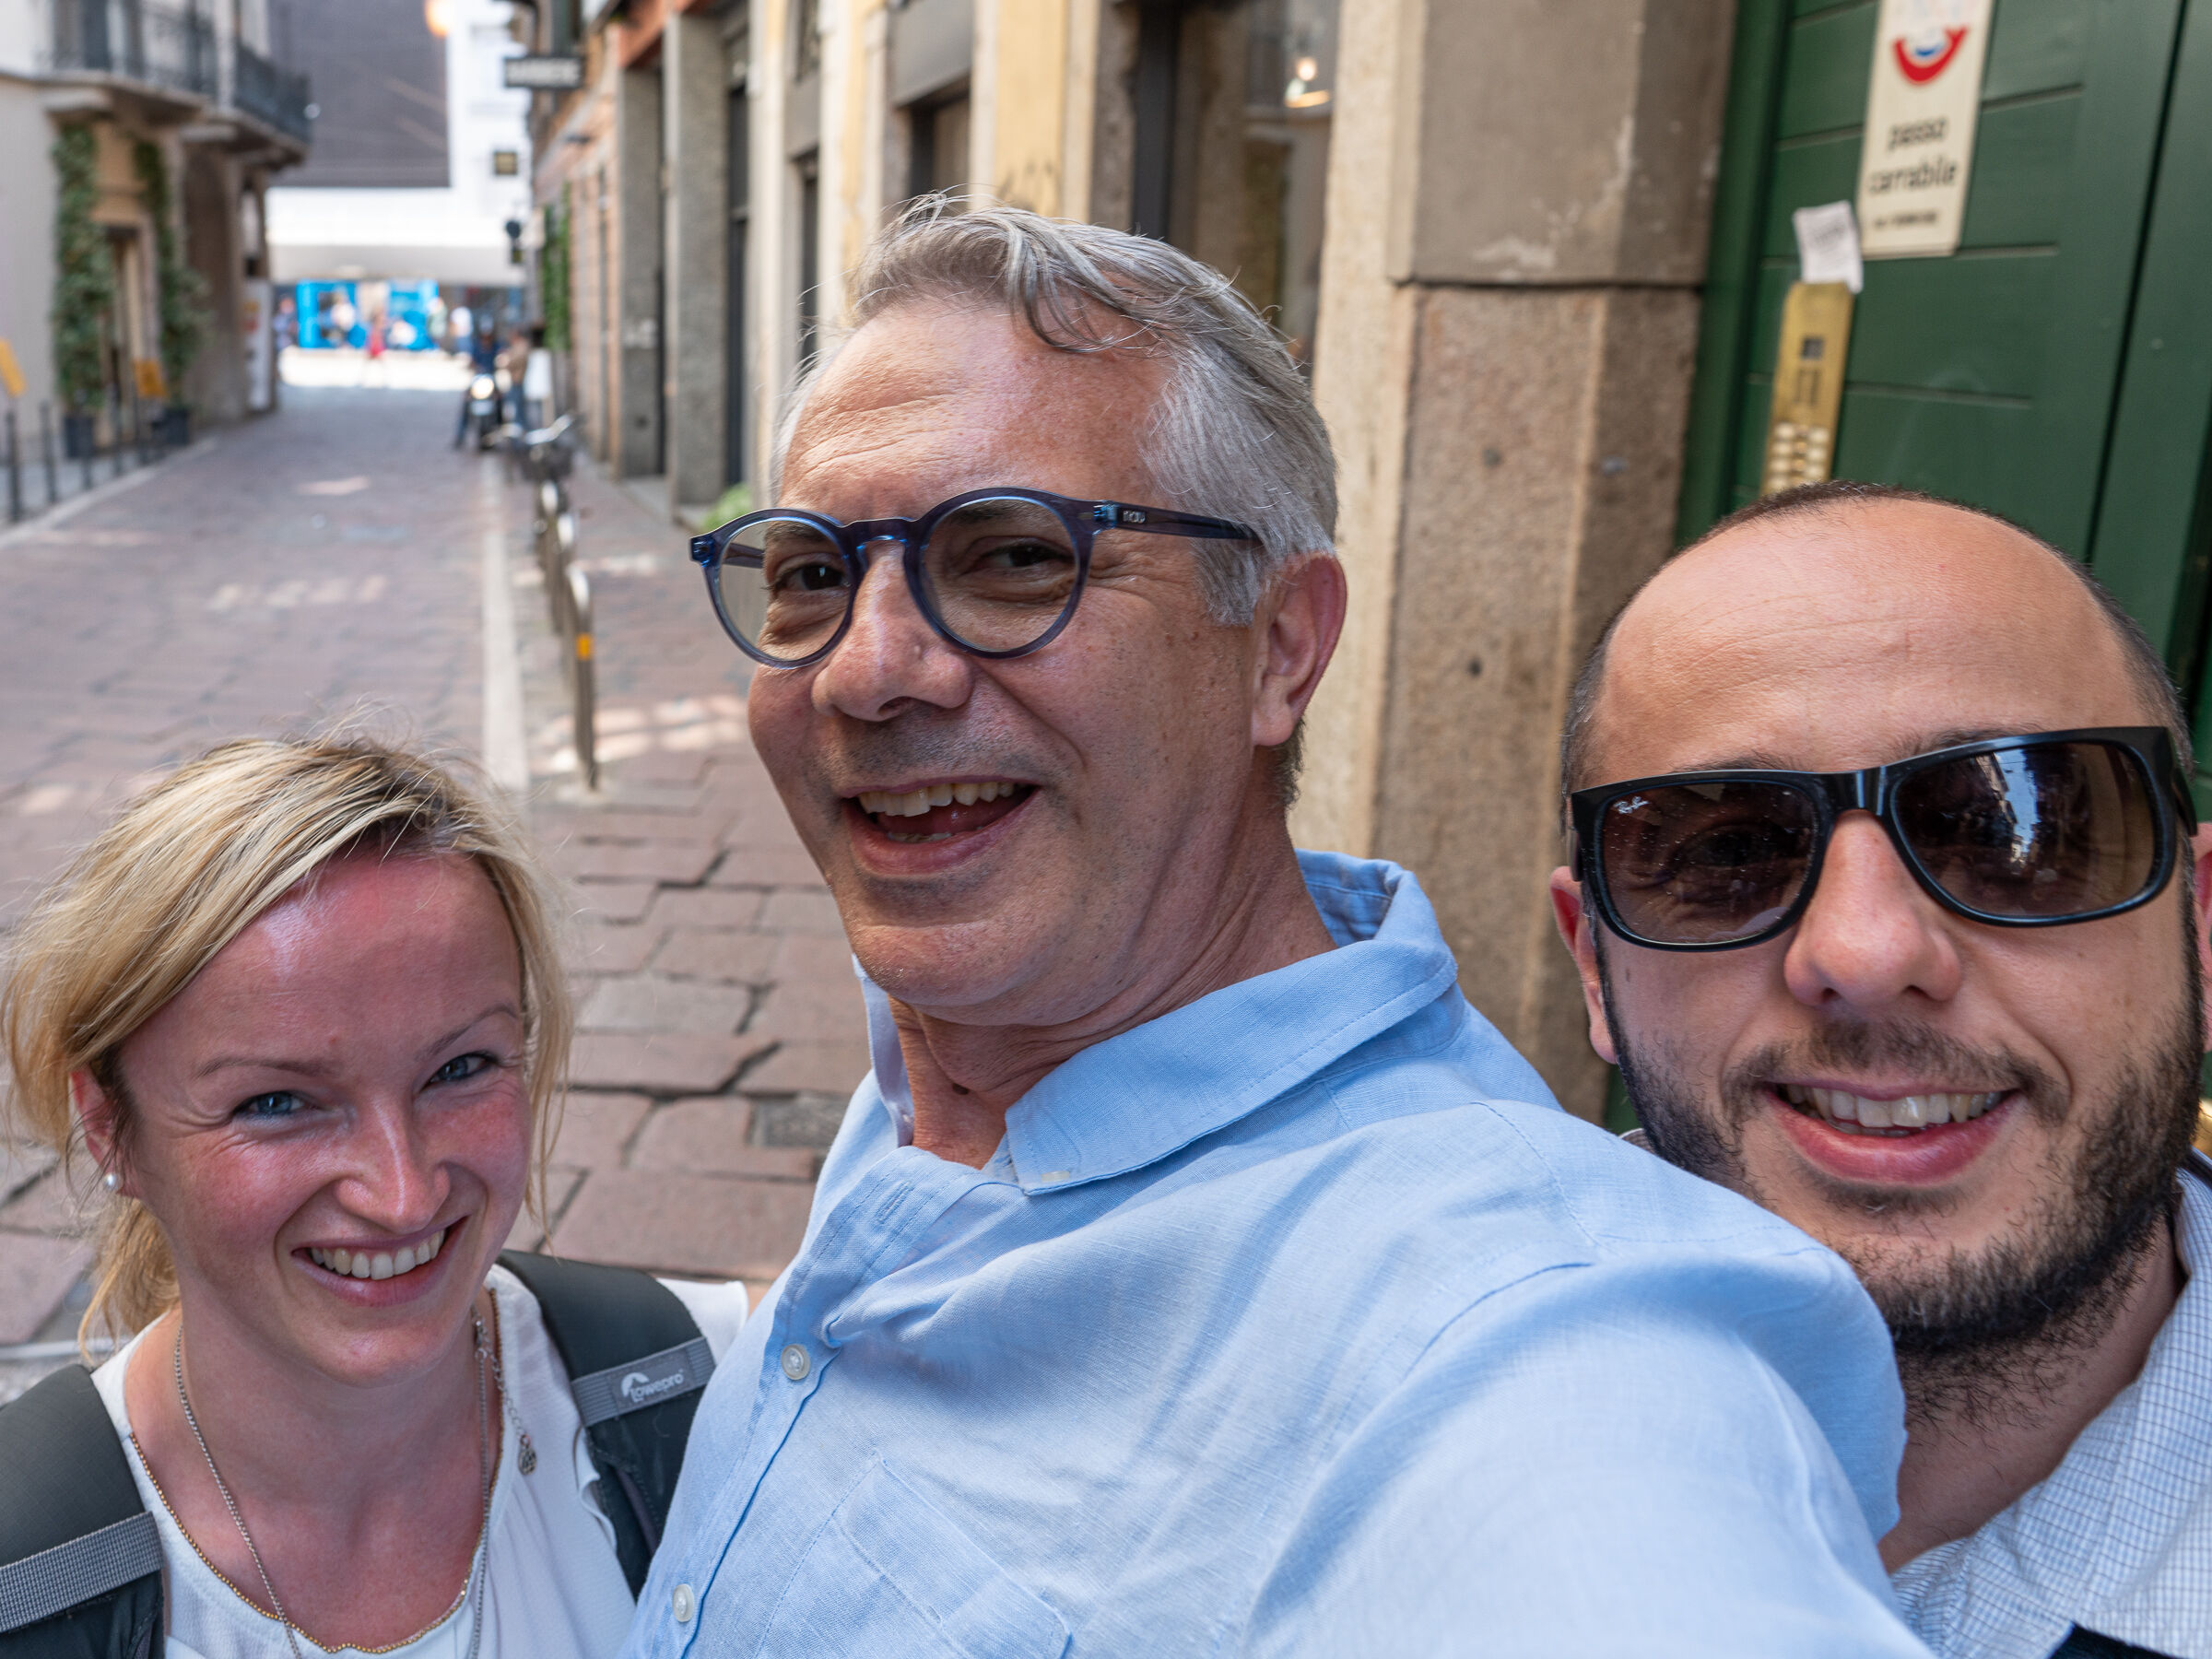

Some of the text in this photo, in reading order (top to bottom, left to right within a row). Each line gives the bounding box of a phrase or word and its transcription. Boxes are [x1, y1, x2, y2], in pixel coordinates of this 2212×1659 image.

[1888, 119, 1947, 150] passo
[1870, 158, 1957, 194] carrabile
[630, 1373, 684, 1402] Lowepro
